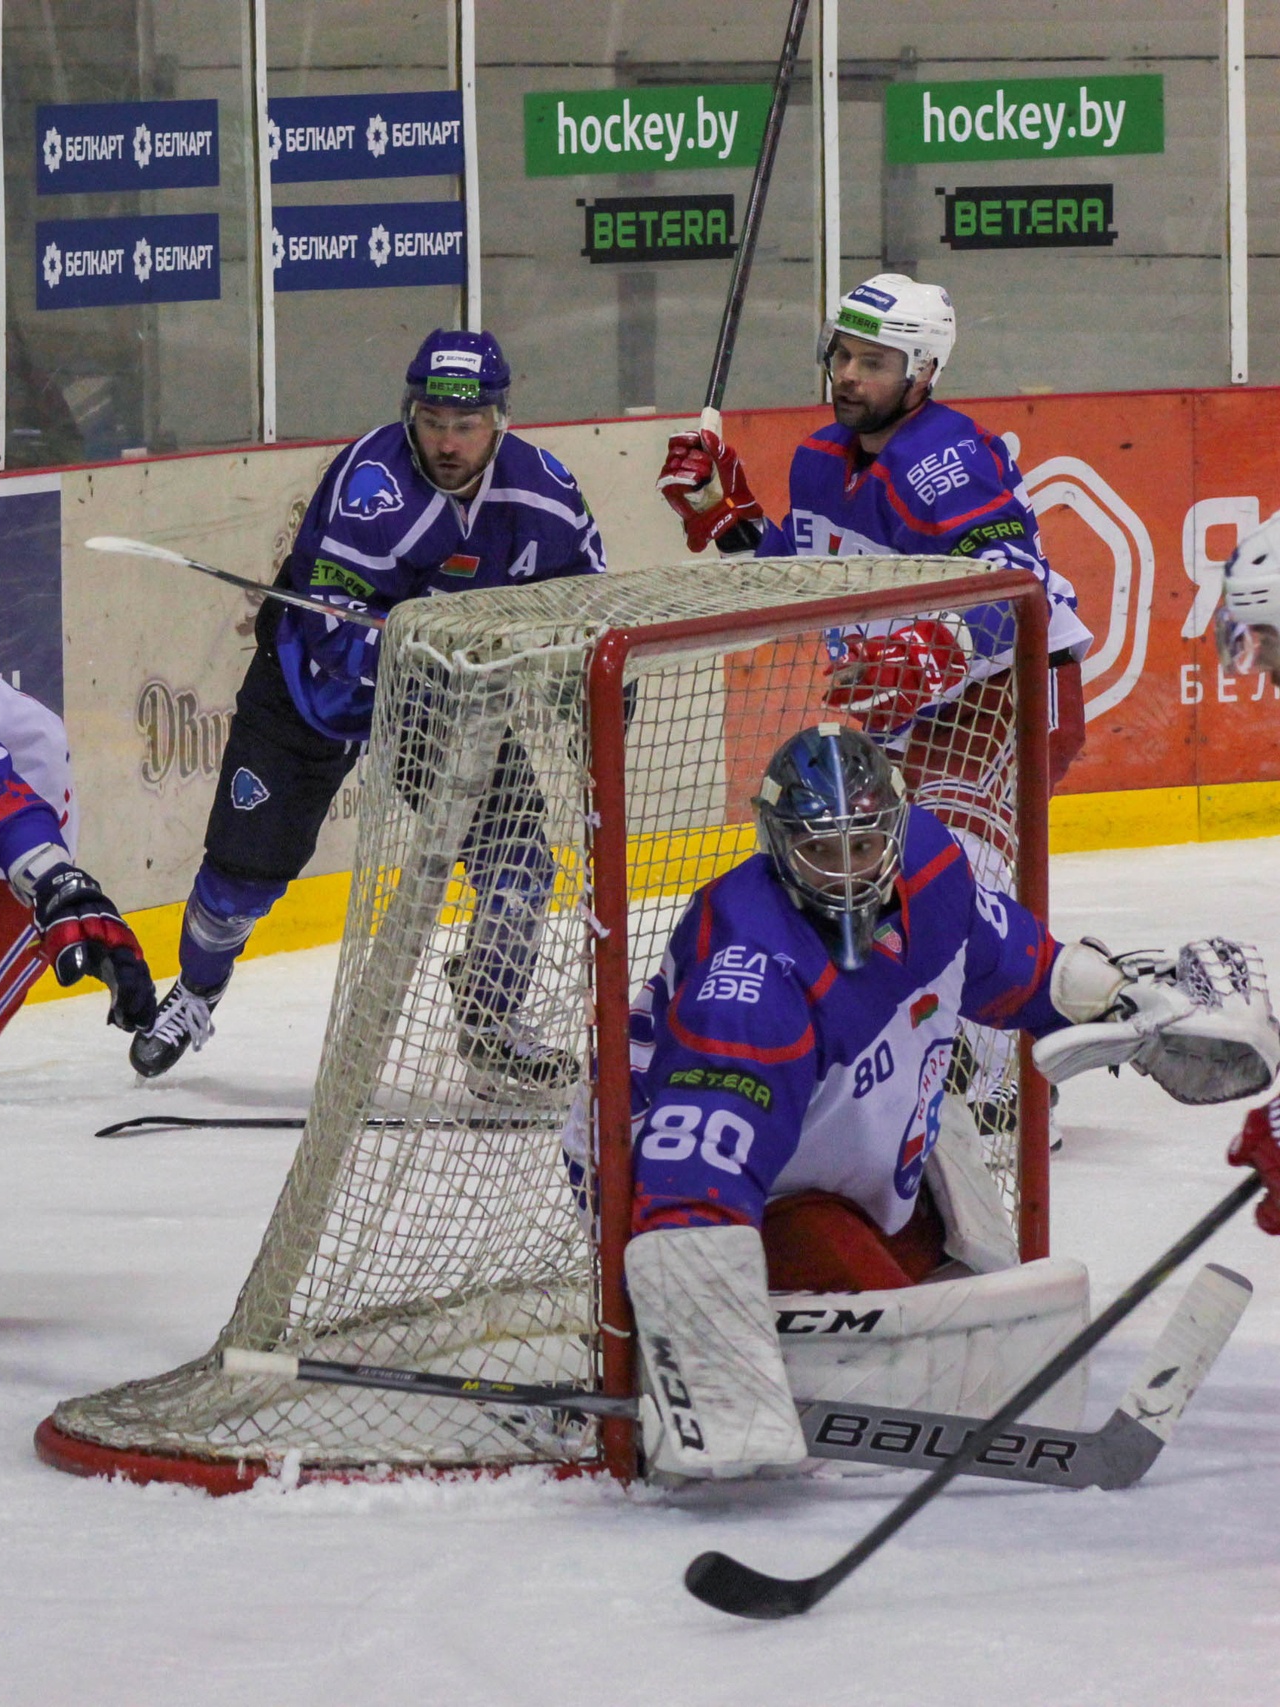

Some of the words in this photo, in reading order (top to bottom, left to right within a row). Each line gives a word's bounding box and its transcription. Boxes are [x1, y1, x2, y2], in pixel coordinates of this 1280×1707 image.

[286, 126, 355, 152] БЕЛКАРТ
[392, 120, 461, 147] БЕЛКАРТ
[557, 96, 738, 162] hockey.by
[923, 86, 1126, 150] hockey.by
[66, 134, 124, 162] БЕЛКАРТ
[155, 131, 212, 158] БЕЛКАРТ
[66, 249, 124, 277] БЕЛКАРТ
[155, 245, 213, 272] БЕЛКАРТ
[289, 235, 358, 261] БЕЛКАРТ
[394, 231, 463, 257] БЕЛКАРТ
[508, 540, 538, 577] A
[697, 978, 762, 1004] ВЭБ
[852, 1039, 895, 1099] 80
[641, 1105, 755, 1176] 80
[815, 1413, 1078, 1472] BAUER
